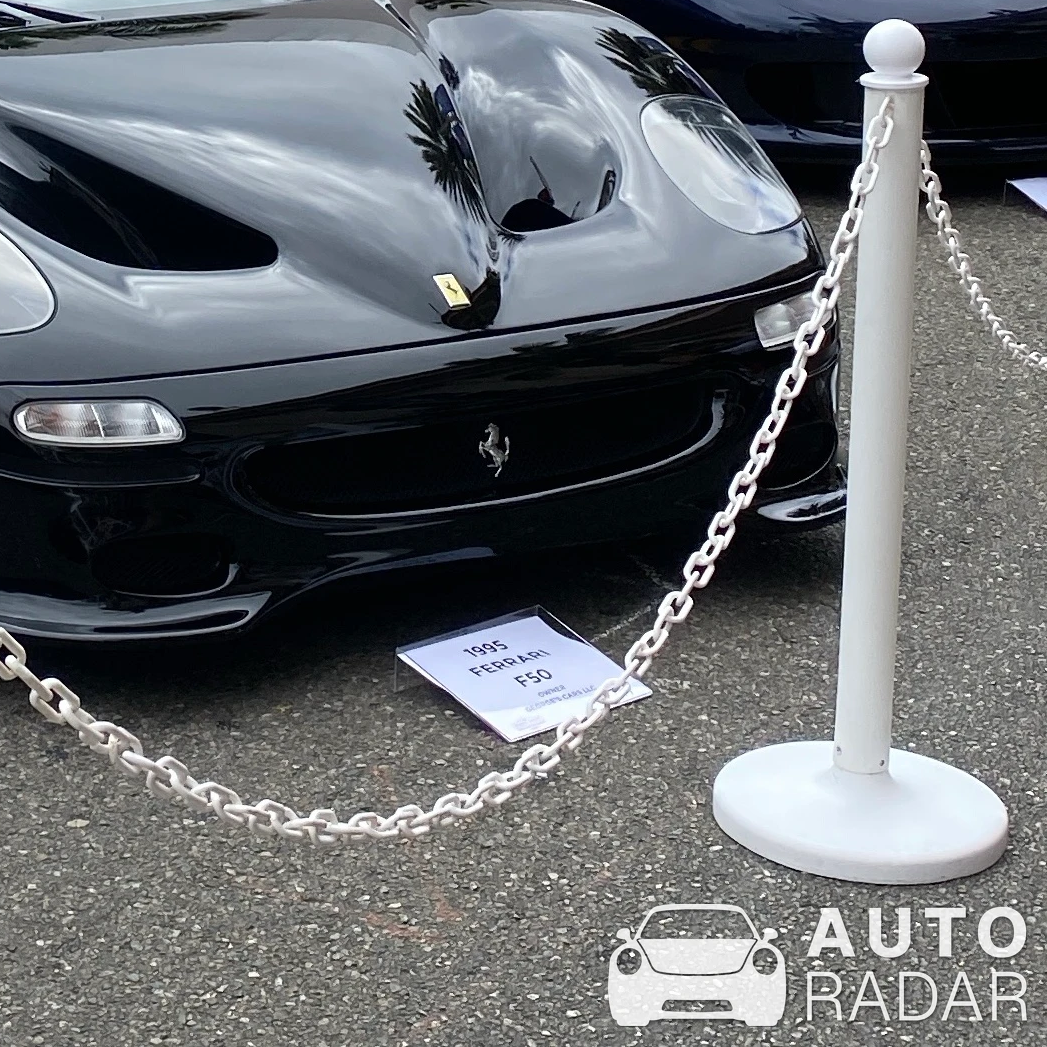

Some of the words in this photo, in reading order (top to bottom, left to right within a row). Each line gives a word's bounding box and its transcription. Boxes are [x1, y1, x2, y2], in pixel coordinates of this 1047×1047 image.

[462, 639, 509, 658] 1995
[468, 649, 552, 677] FERRARI
[513, 668, 553, 688] F50
[537, 684, 566, 698] OWNER
